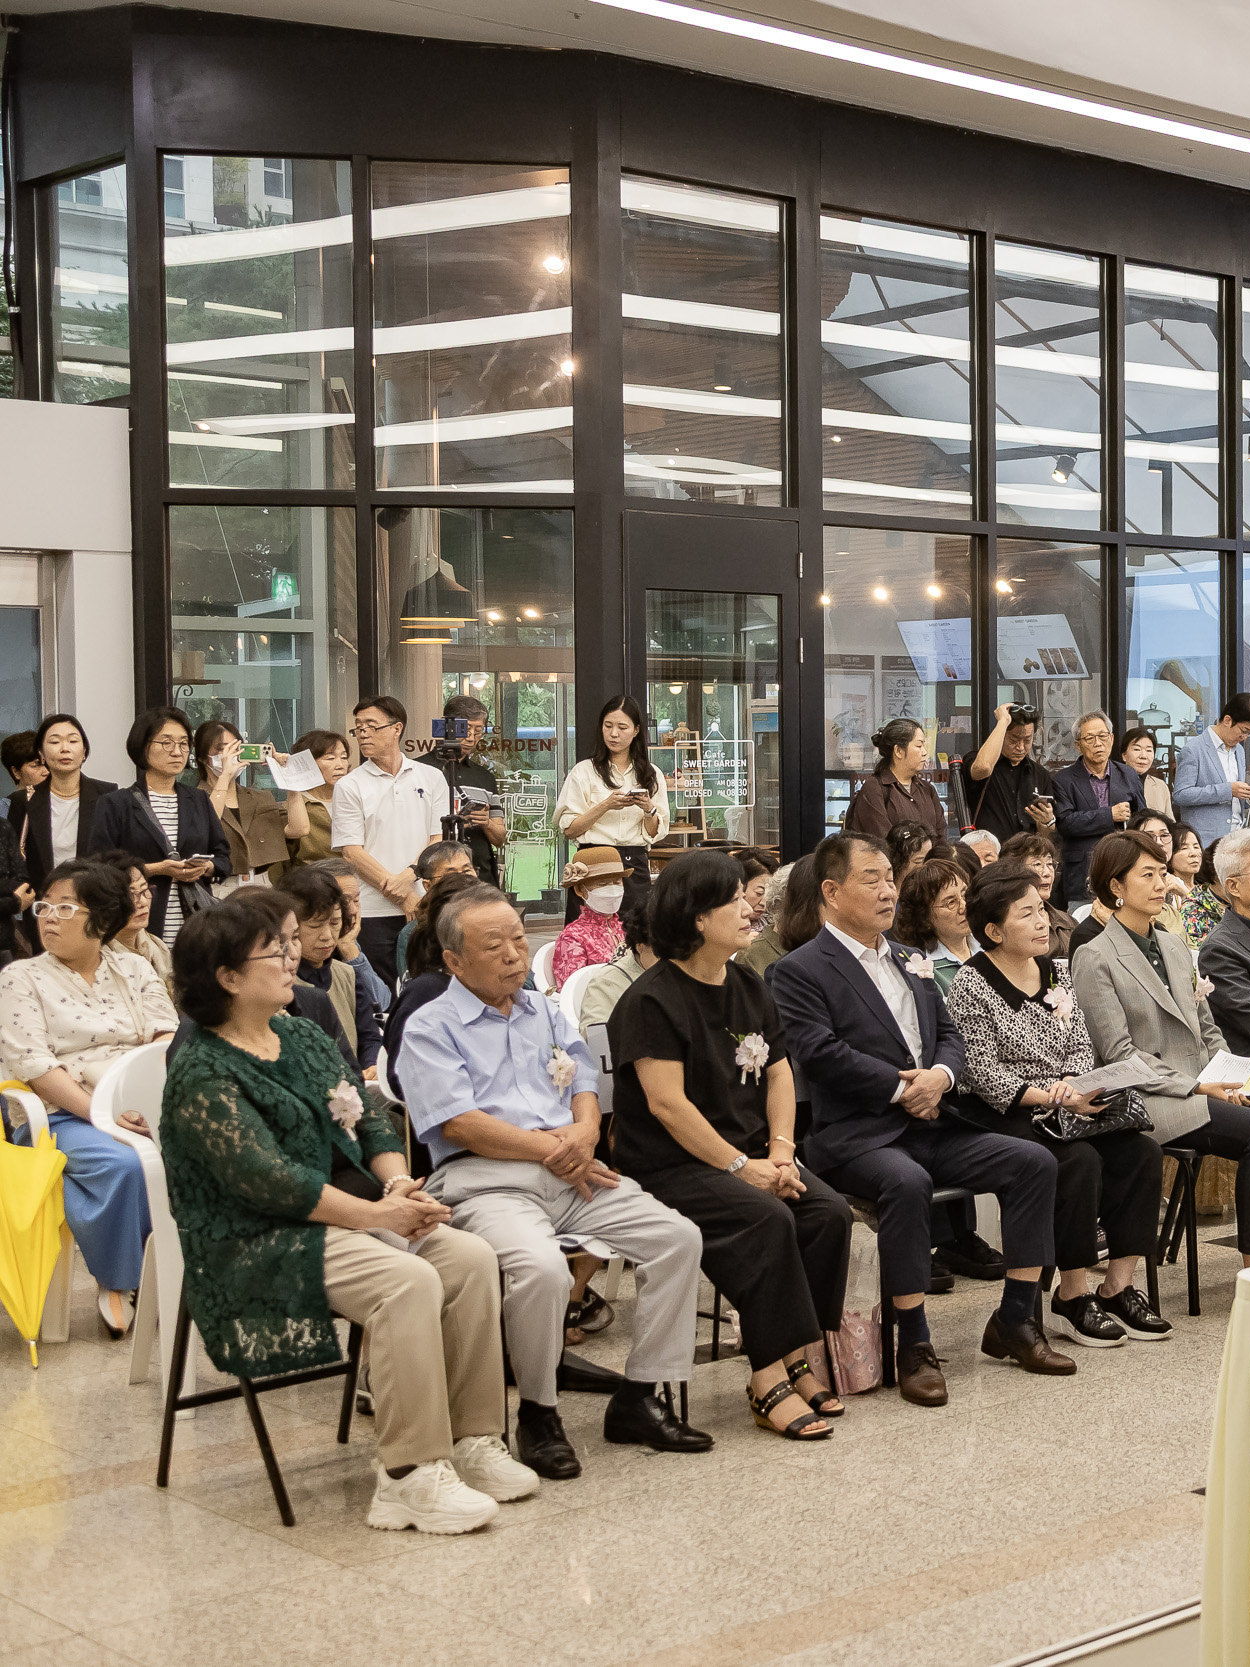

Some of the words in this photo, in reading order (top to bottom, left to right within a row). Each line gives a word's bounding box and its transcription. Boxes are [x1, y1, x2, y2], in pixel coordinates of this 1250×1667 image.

[475, 738, 552, 752] GARDEN
[704, 749, 726, 759] Cafe
[683, 759, 712, 768] SWEET
[713, 758, 747, 768] GARDEN
[683, 779, 704, 788] OPEN
[726, 778, 748, 787] 0830
[684, 788, 713, 798] CLOSED
[726, 788, 748, 797] 0830
[518, 798, 544, 806] CAFE
